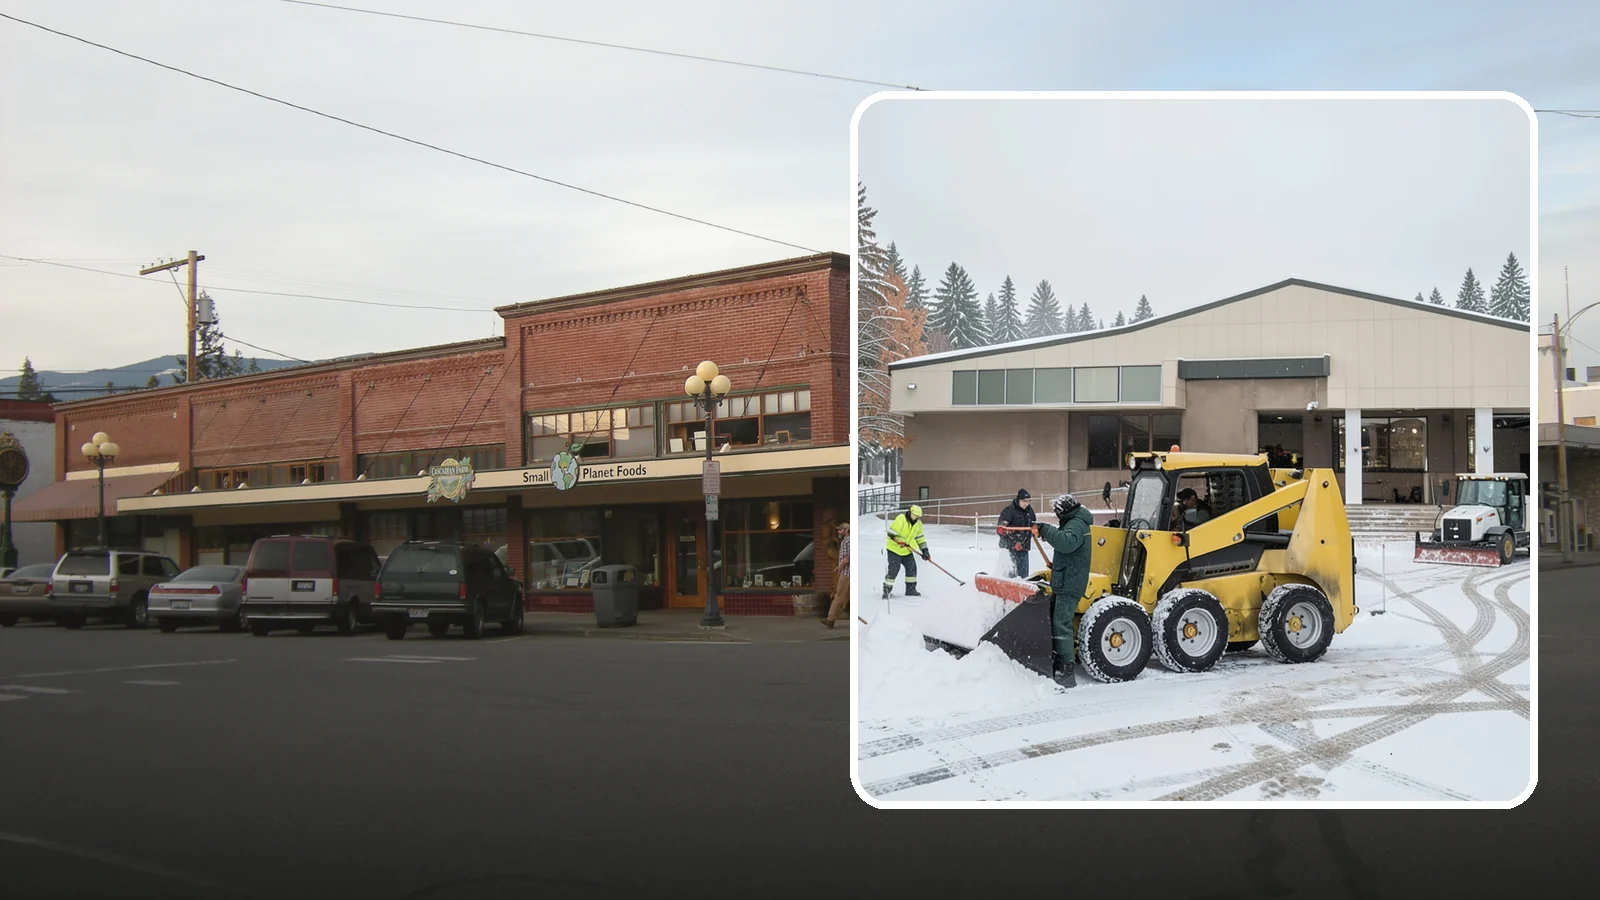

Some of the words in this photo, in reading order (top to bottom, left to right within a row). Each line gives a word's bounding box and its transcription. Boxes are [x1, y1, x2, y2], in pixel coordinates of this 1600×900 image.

[523, 470, 549, 483] Small
[582, 467, 614, 480] Planet
[616, 464, 647, 477] Foods
